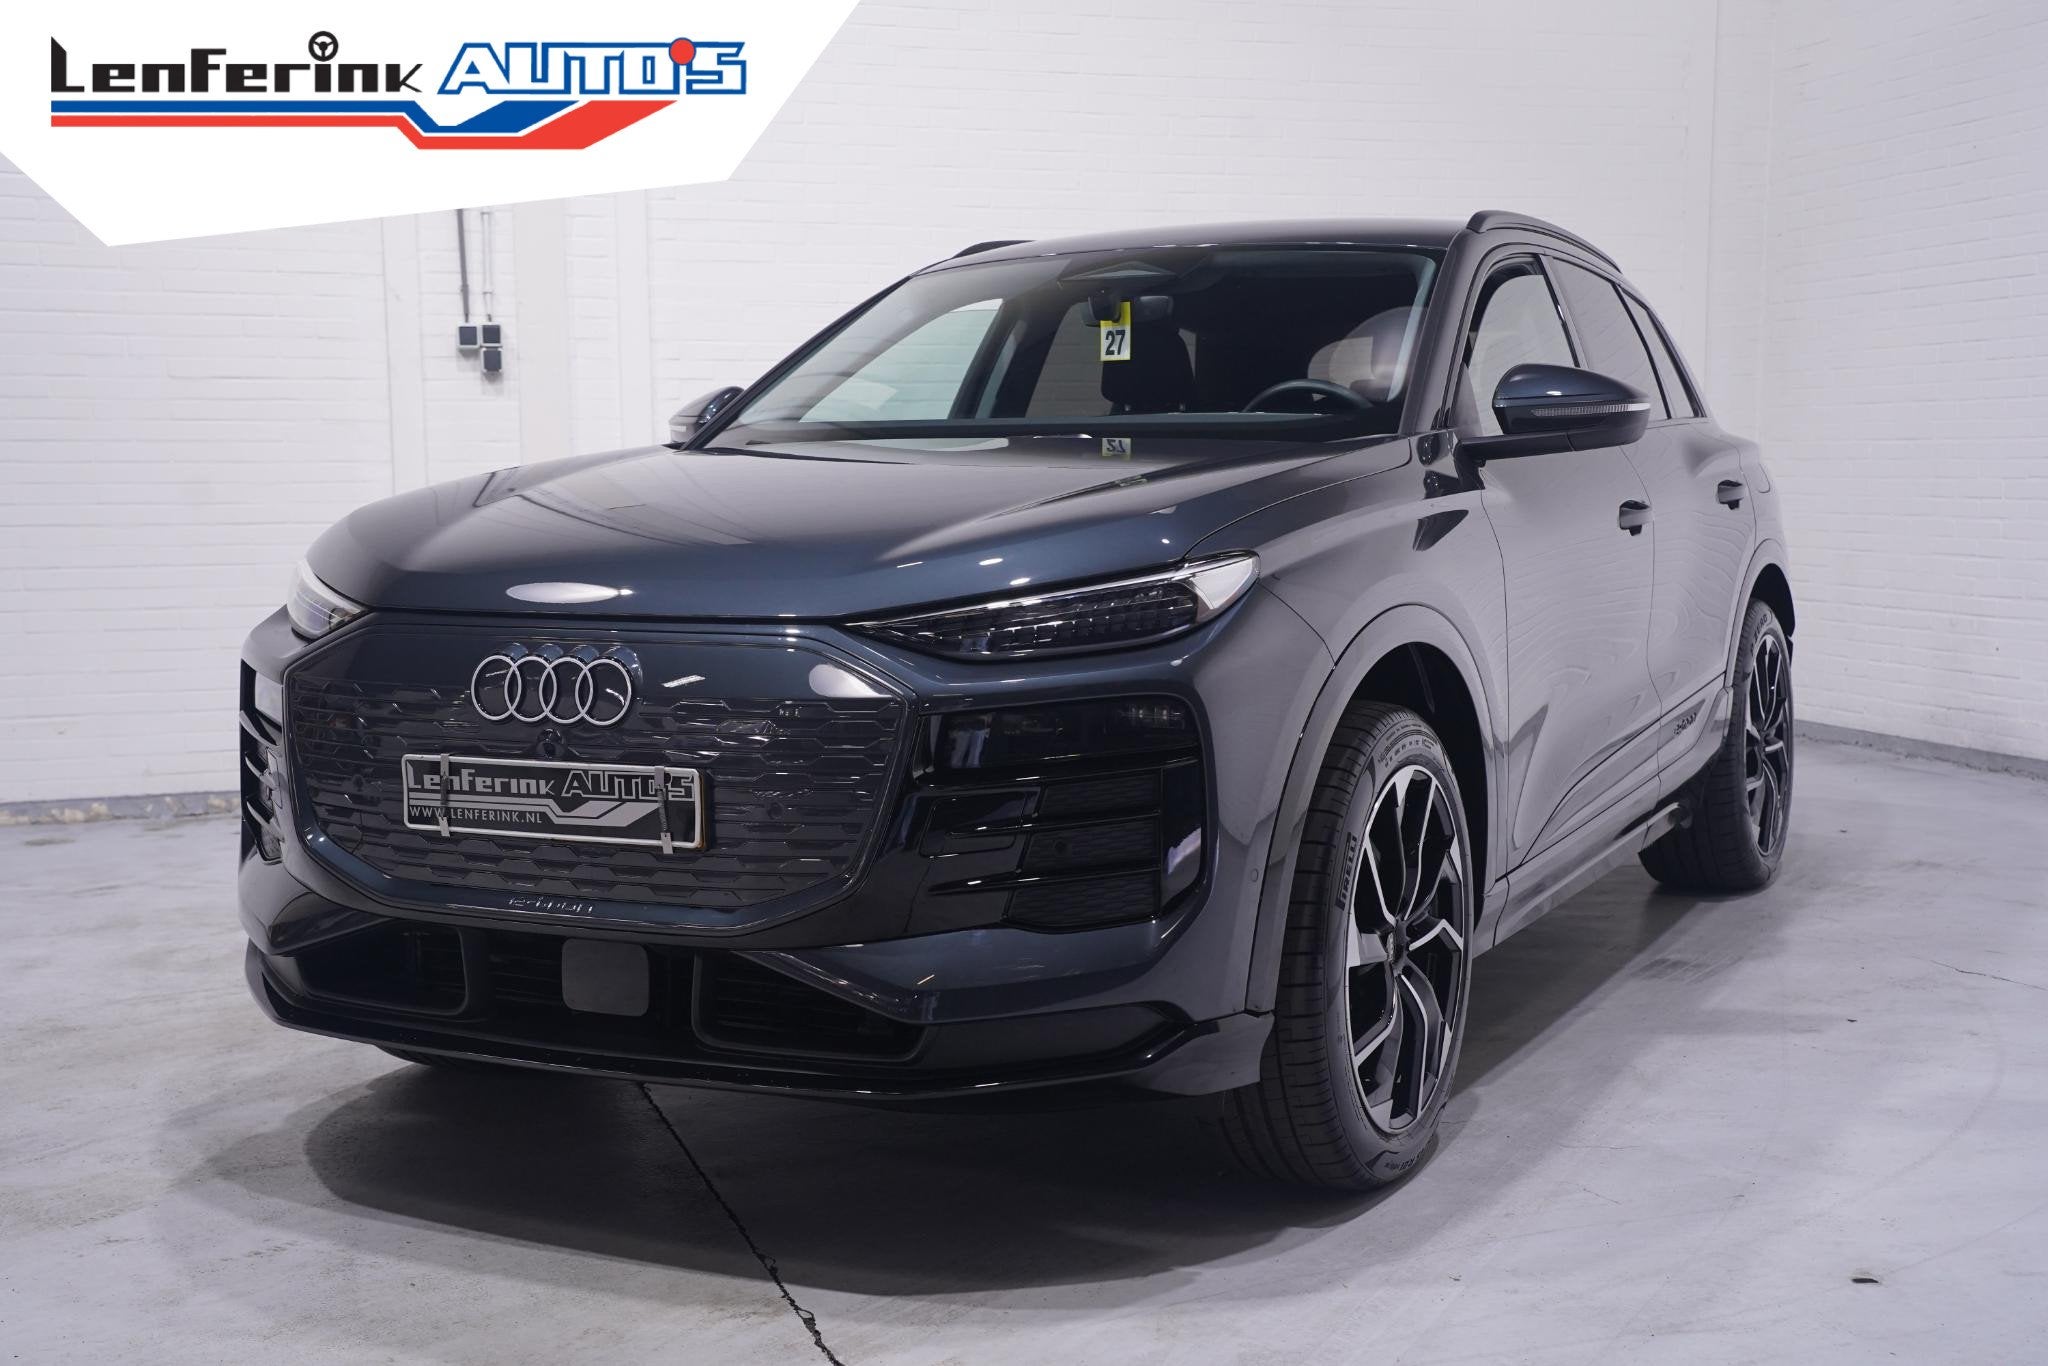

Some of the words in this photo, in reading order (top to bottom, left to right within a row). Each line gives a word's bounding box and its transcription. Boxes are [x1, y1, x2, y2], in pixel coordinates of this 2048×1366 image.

[1105, 329, 1126, 356] 27
[406, 760, 555, 796] Lenferink
[1334, 831, 1359, 912] PIRELLI
